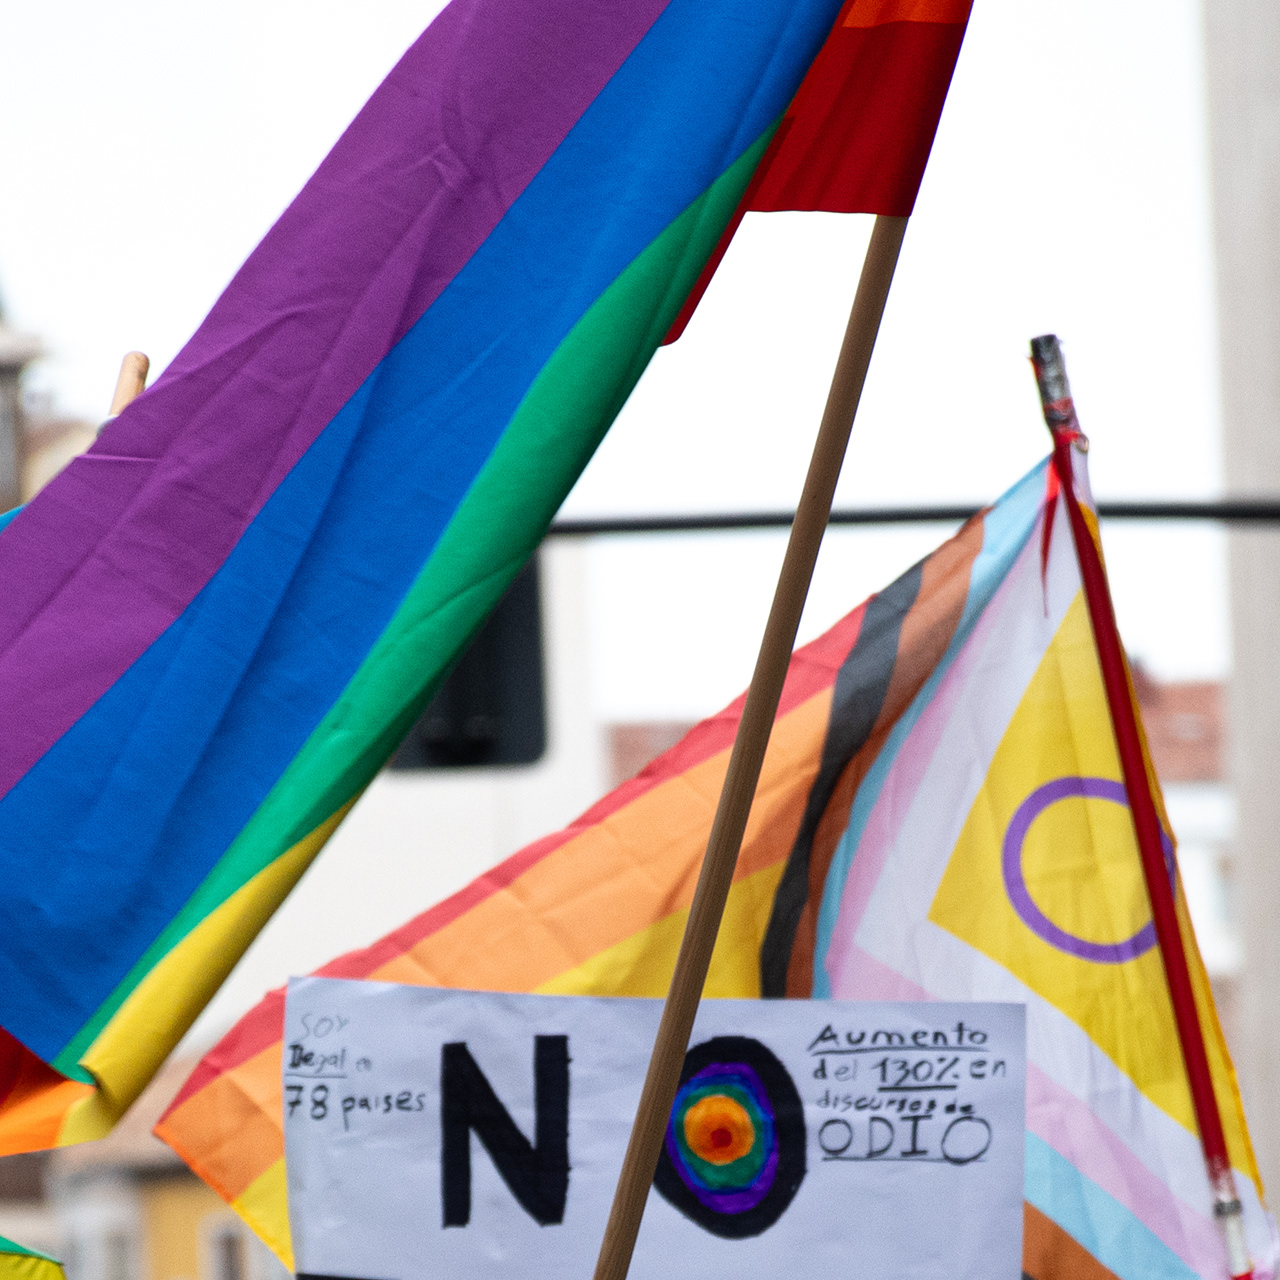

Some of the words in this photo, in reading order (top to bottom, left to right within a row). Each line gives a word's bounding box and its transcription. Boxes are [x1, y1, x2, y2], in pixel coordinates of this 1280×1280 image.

[808, 1021, 988, 1050] Aumento
[813, 1058, 858, 1082] del
[871, 1056, 960, 1087] 130%
[970, 1060, 1007, 1080] en
[285, 1084, 329, 1121] 78
[816, 1088, 937, 1114] discursos
[441, 1033, 808, 1240] NO
[818, 1114, 993, 1167] ODIO
